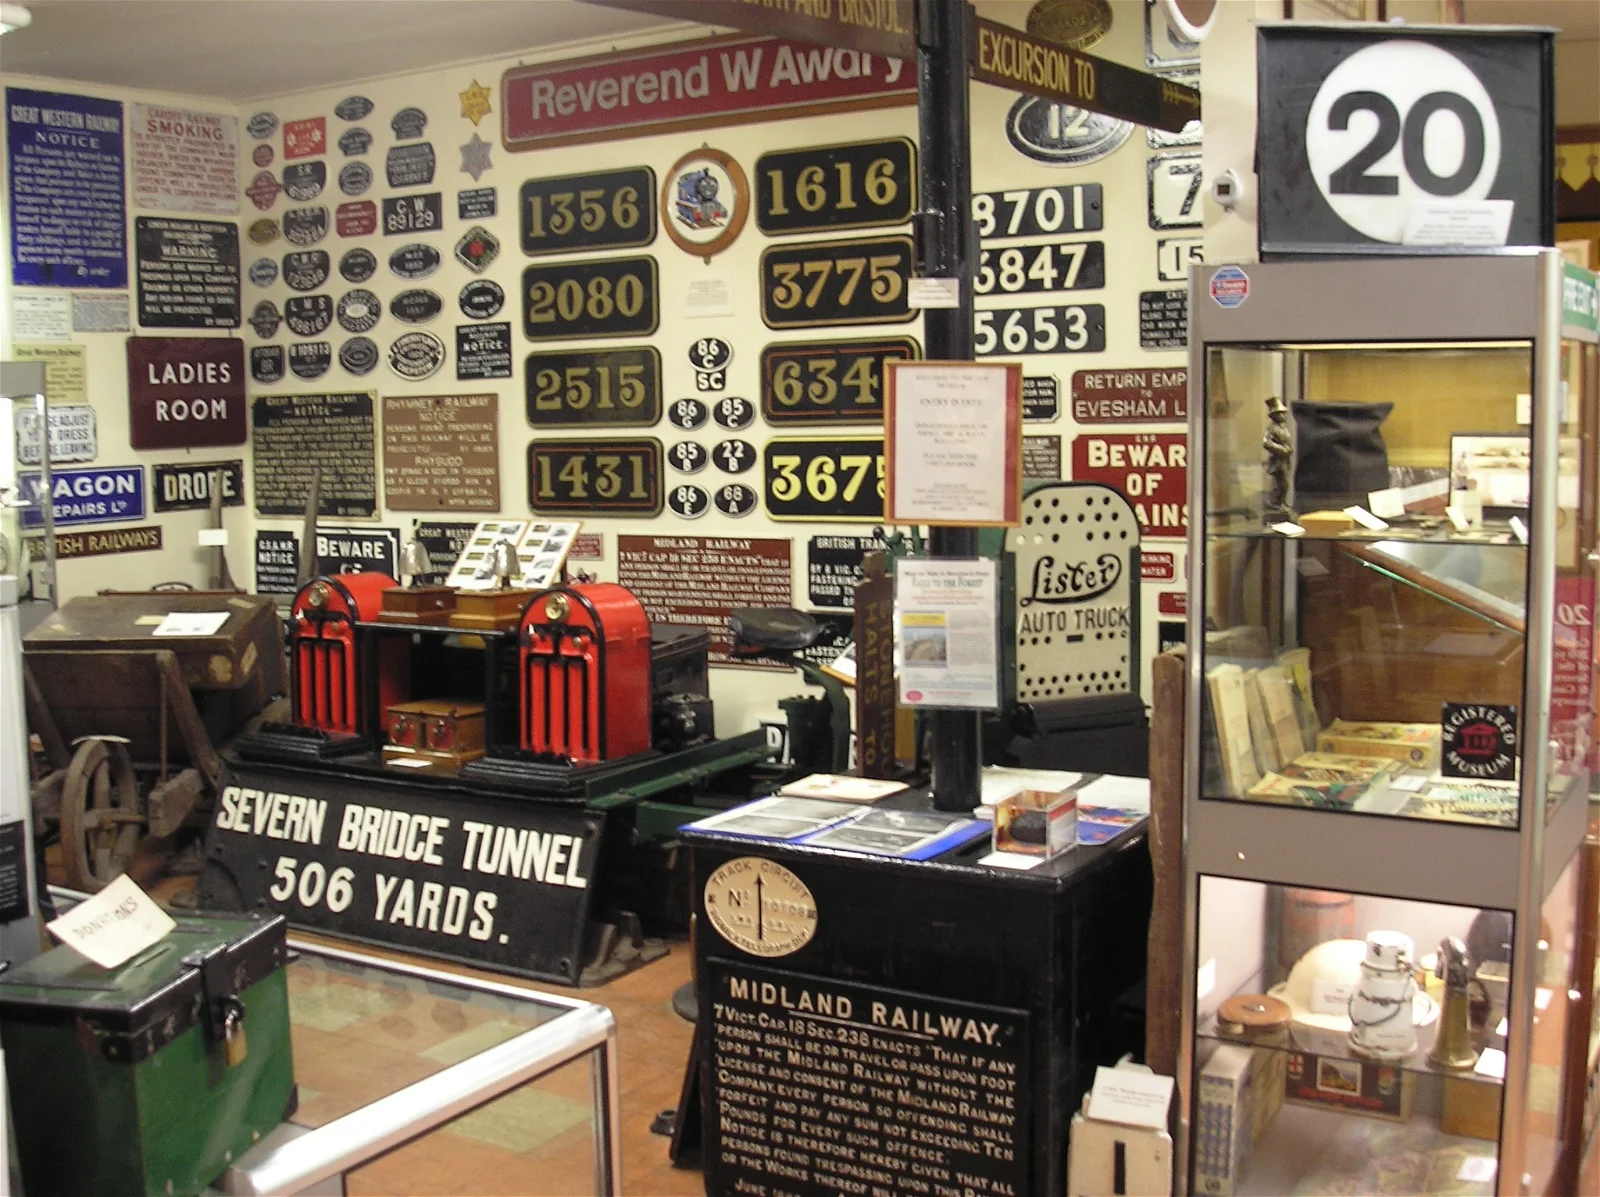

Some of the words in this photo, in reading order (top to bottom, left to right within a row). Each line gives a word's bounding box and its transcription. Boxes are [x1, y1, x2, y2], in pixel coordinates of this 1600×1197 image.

[979, 31, 1070, 94] EXCURSION
[1075, 60, 1096, 100] TO
[531, 56, 709, 120] Reverend
[720, 47, 763, 93] W
[36, 130, 100, 149] NOTICE
[147, 119, 223, 141] SMOKING
[1327, 90, 1486, 197] 20
[766, 158, 899, 217] 1616
[1169, 163, 1202, 217] 7
[387, 208, 435, 232] 89129
[527, 185, 642, 239] 1356
[973, 185, 1084, 237] 8701
[161, 245, 219, 259] WARNING
[771, 255, 904, 310] 3775
[529, 273, 645, 324] 2080
[973, 306, 1089, 353] 5653
[463, 340, 504, 352] NOTICE
[697, 339, 720, 356] 86
[148, 362, 232, 385] LADIES
[702, 354, 715, 369] C
[535, 364, 647, 411] 2515
[697, 372, 724, 390] SC
[773, 355, 884, 407] 634
[1084, 374, 1146, 390] RETURN
[1151, 371, 1187, 389] EMP
[155, 399, 228, 422] ROOM
[294, 404, 330, 416] NOTICE
[677, 400, 698, 417] 86
[721, 398, 745, 416] 85
[1075, 400, 1167, 418] EVESHAM
[727, 414, 739, 428] C
[58, 428, 89, 442] DRESS
[676, 442, 699, 460] 85
[722, 441, 745, 458] 22
[1087, 439, 1187, 468] BEWAR
[682, 458, 693, 472] B
[728, 456, 739, 472] B
[537, 455, 650, 499] 1431
[1126, 473, 1162, 496] OF
[677, 486, 698, 502] 86
[53, 501, 107, 518] EPAIRS
[684, 501, 693, 516] E
[729, 500, 739, 514] A
[88, 529, 158, 551] RAILWAYS
[316, 536, 386, 560] BEWARE
[653, 538, 699, 548] MIDLAND
[706, 539, 752, 550] RAILWAY
[816, 538, 856, 550] BRITISH
[258, 552, 294, 564] NOTICE
[1020, 553, 1123, 607] Lister
[1021, 610, 1067, 635] AUTO
[1074, 605, 1132, 632] TRUCK
[1443, 706, 1516, 745] REGISTERED
[1446, 750, 1511, 777] MUSEUM
[216, 786, 328, 845] SEVERN
[338, 803, 451, 866] BRIDGE
[462, 820, 588, 889] TUNNEL
[712, 859, 752, 886] TRACK
[760, 861, 810, 899] CIRCUIT
[269, 856, 356, 914] 506
[375, 872, 509, 945] YARDS.
[730, 975, 853, 1019] MIDLAND
[871, 1001, 1002, 1047] RAILWAY.
[713, 1003, 724, 1019] 7
[788, 1018, 806, 1035] 18
[872, 1037, 921, 1057] ENACTS
[971, 1055, 986, 1069] IF
[988, 1060, 1016, 1075] ANY
[764, 1032, 801, 1050] SHALL
[804, 1041, 821, 1054] BE
[823, 1043, 840, 1056] OR
[841, 1047, 890, 1068] TRAVEL
[891, 1058, 908, 1071] OR
[909, 1061, 941, 1077] PASS
[942, 1068, 977, 1085] UPON
[980, 1074, 1016, 1092] FOOT
[756, 1046, 782, 1062] THE
[787, 1050, 848, 1074] MIDLAND
[853, 1063, 910, 1087] RAILWAY
[916, 1079, 978, 1100] WITHOUT
[985, 1093, 1015, 1110] THE
[768, 1066, 791, 1080] AND
[792, 1071, 847, 1091] CONSENT
[851, 1082, 866, 1094] OF
[870, 1086, 894, 1101] THE
[896, 1089, 957, 1114] MIDLAND
[958, 1102, 1015, 1127] RAILWAY
[772, 1115, 797, 1130] FOR
[822, 1093, 870, 1113] PERSON
[875, 1105, 893, 1118] SO
[972, 1124, 1014, 1144] SHALL
[774, 1100, 798, 1114] AND
[800, 1105, 822, 1119] PAY
[826, 1111, 850, 1125] ANY
[883, 1123, 908, 1138] NOT
[982, 1141, 1014, 1162] TEN
[720, 1115, 766, 1140] NOTICE
[911, 1162, 950, 1181] GIVEN
[955, 1172, 989, 1190] THAT
[990, 1180, 1015, 1197] ALL
